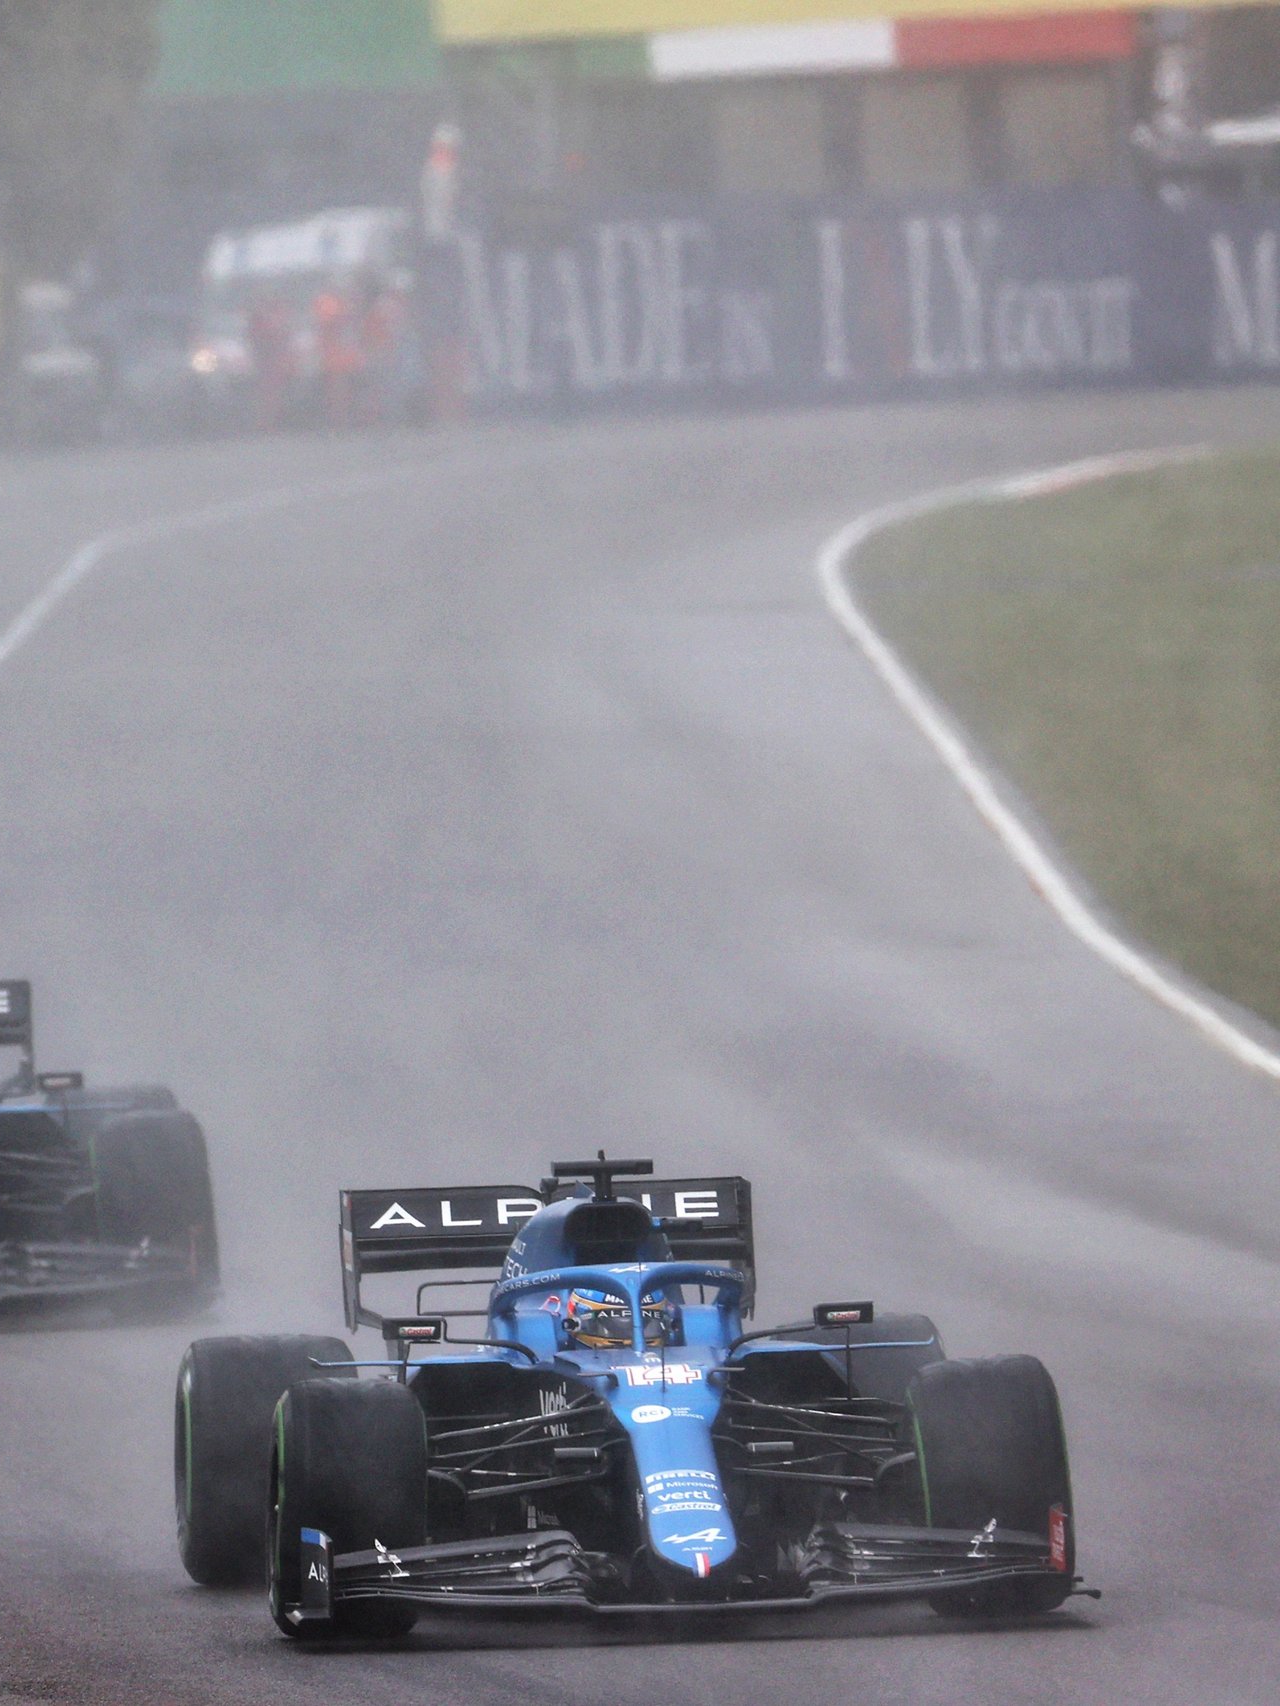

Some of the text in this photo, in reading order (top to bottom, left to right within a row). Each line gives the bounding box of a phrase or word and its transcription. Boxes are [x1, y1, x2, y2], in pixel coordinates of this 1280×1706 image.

[369, 1190, 720, 1230] ALPE
[597, 1309, 662, 1319] ALPNE
[625, 1364, 702, 1387] 14
[657, 1490, 711, 1502] verti
